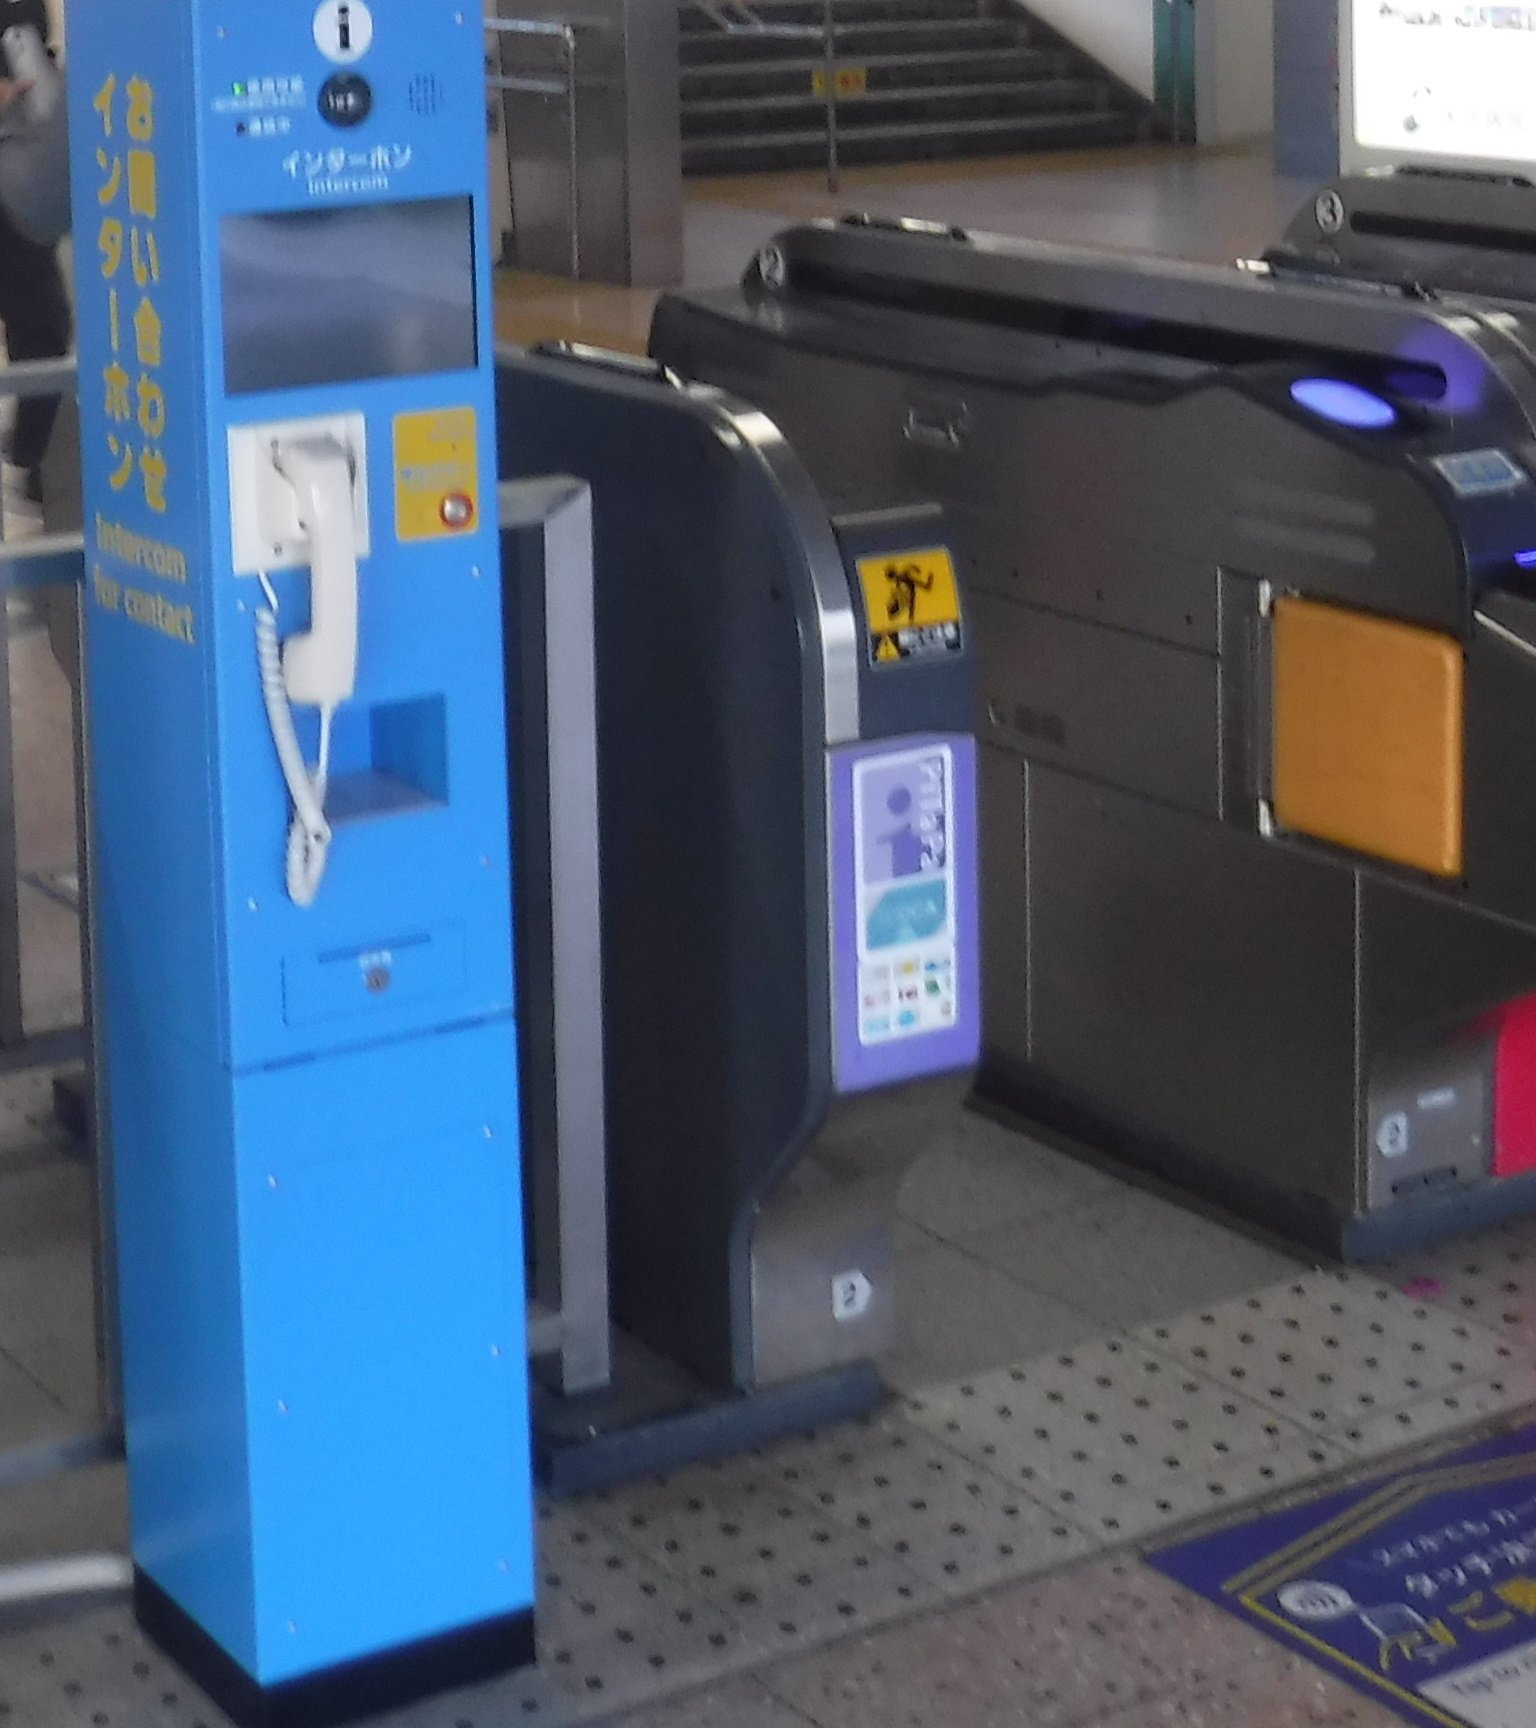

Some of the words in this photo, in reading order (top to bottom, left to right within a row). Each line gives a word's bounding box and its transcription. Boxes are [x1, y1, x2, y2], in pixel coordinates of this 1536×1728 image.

[282, 142, 412, 180] インターホン
[1321, 192, 1339, 231] 3
[92, 71, 133, 490] インターホン
[125, 75, 167, 513] お問い合わせ
[94, 512, 187, 585] Intercom
[93, 563, 121, 611] for
[124, 585, 195, 645] contact
